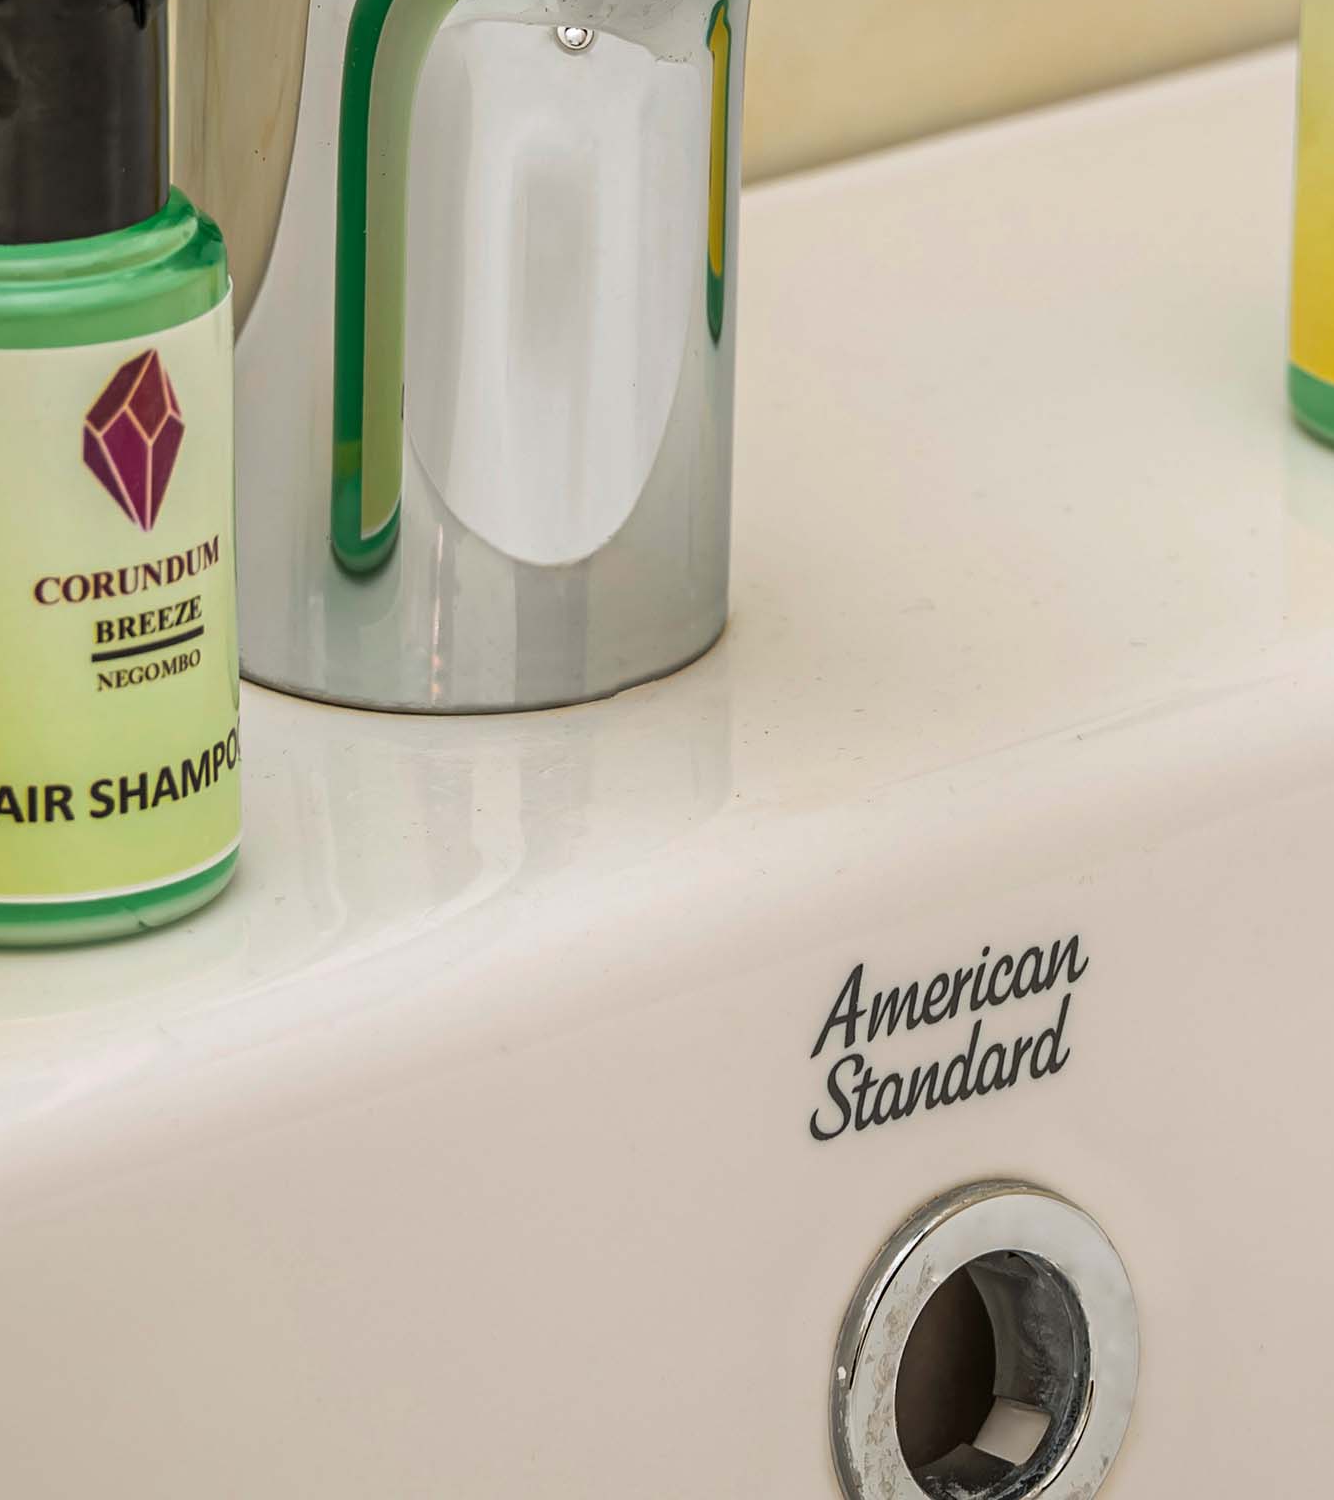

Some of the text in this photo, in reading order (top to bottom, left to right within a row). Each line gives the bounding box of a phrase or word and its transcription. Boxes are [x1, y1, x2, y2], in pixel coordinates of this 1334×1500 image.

[33, 534, 220, 606] CORUNDUM
[94, 595, 203, 644] BREEZE
[96, 648, 202, 692] NEGOMBO
[810, 934, 1089, 1060] American
[809, 992, 1071, 1141] Standard
